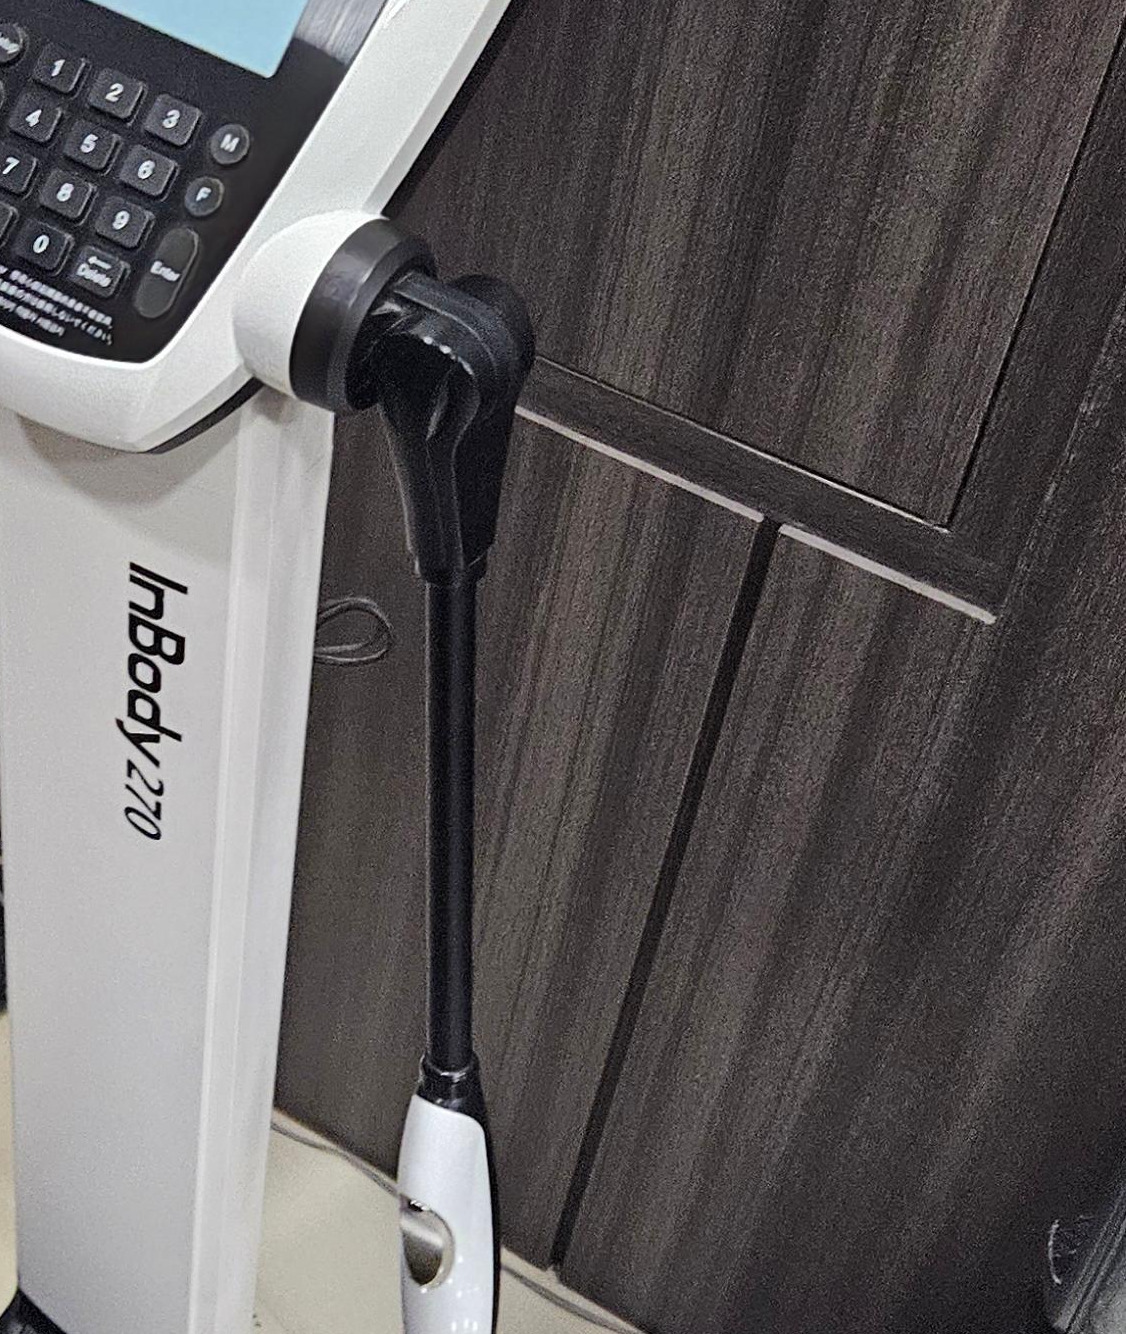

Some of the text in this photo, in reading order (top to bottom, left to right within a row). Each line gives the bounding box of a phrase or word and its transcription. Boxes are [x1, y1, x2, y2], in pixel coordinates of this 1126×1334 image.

[51, 58, 67, 77] 1
[104, 82, 125, 102] 2
[24, 108, 43, 128] 4
[161, 108, 182, 130] 3
[80, 132, 100, 154] 5
[220, 133, 240, 153] M
[1, 156, 21, 175] 7
[136, 160, 157, 180] 6
[56, 182, 75, 203] 8
[195, 185, 213, 203] F
[111, 209, 131, 231] 9
[32, 233, 51, 254] 0
[115, 561, 188, 841] InBody 270
